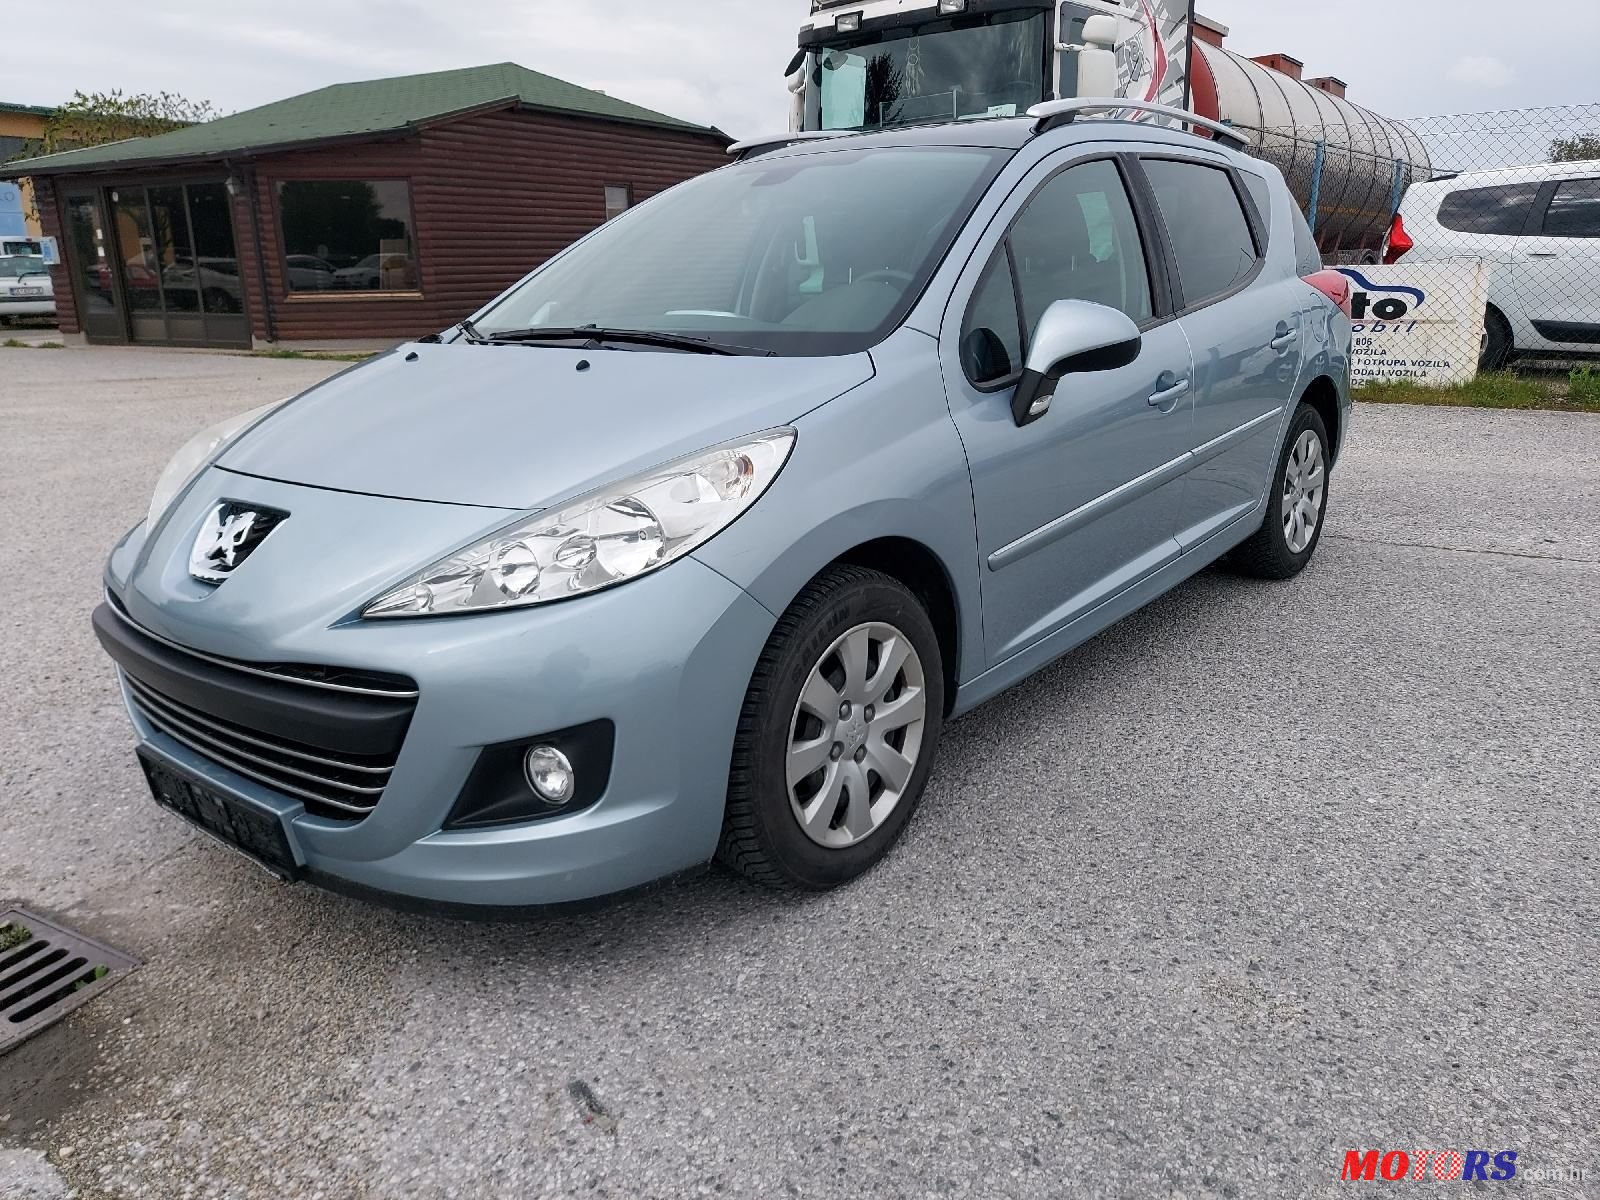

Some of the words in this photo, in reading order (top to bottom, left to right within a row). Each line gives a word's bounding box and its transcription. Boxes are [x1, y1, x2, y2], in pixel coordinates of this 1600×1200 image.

[1364, 359, 1407, 367] OTKUPA
[1410, 360, 1451, 368] VOZILA
[1351, 369, 1386, 377] ODAJI
[1388, 370, 1427, 378] VOZILA
